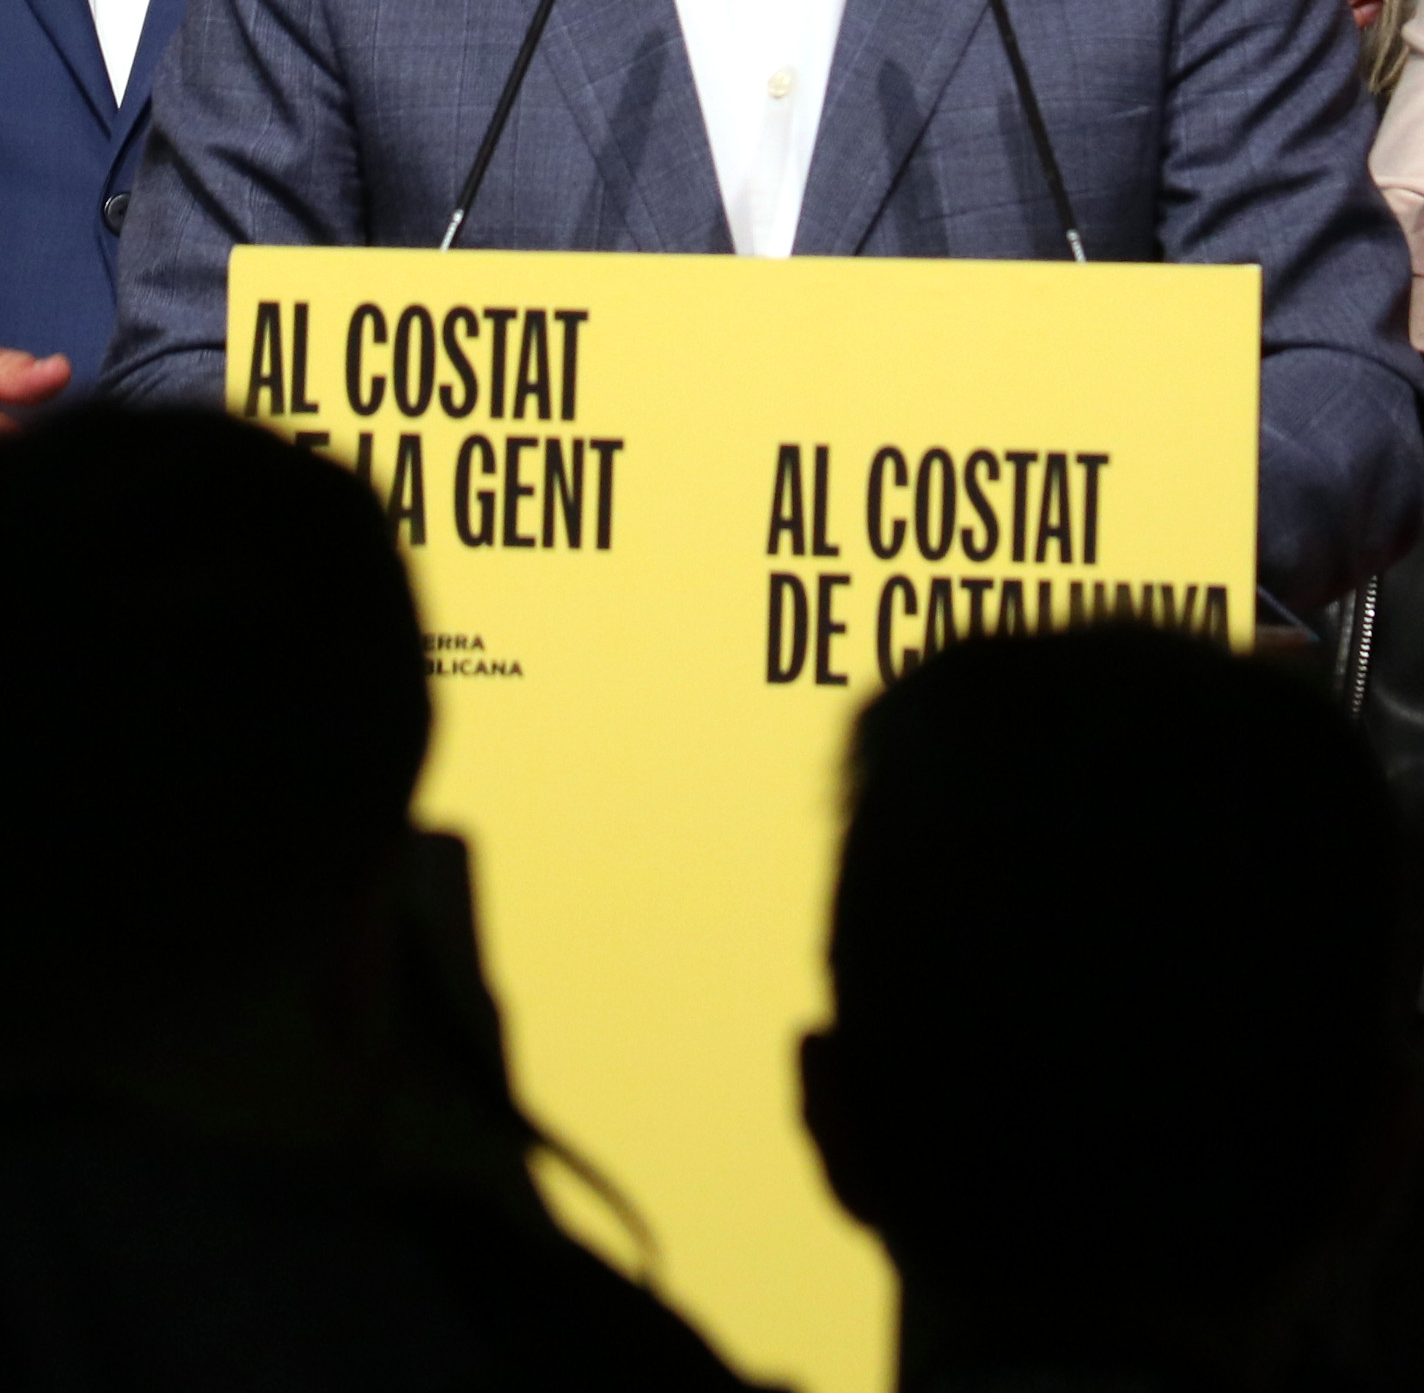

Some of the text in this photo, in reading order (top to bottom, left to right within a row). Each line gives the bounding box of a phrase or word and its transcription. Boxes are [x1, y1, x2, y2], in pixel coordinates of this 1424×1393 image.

[245, 301, 589, 421] AL COSTAT
[454, 434, 624, 550] GENT
[766, 443, 1110, 565] AL COSTAT
[766, 572, 851, 686] DE
